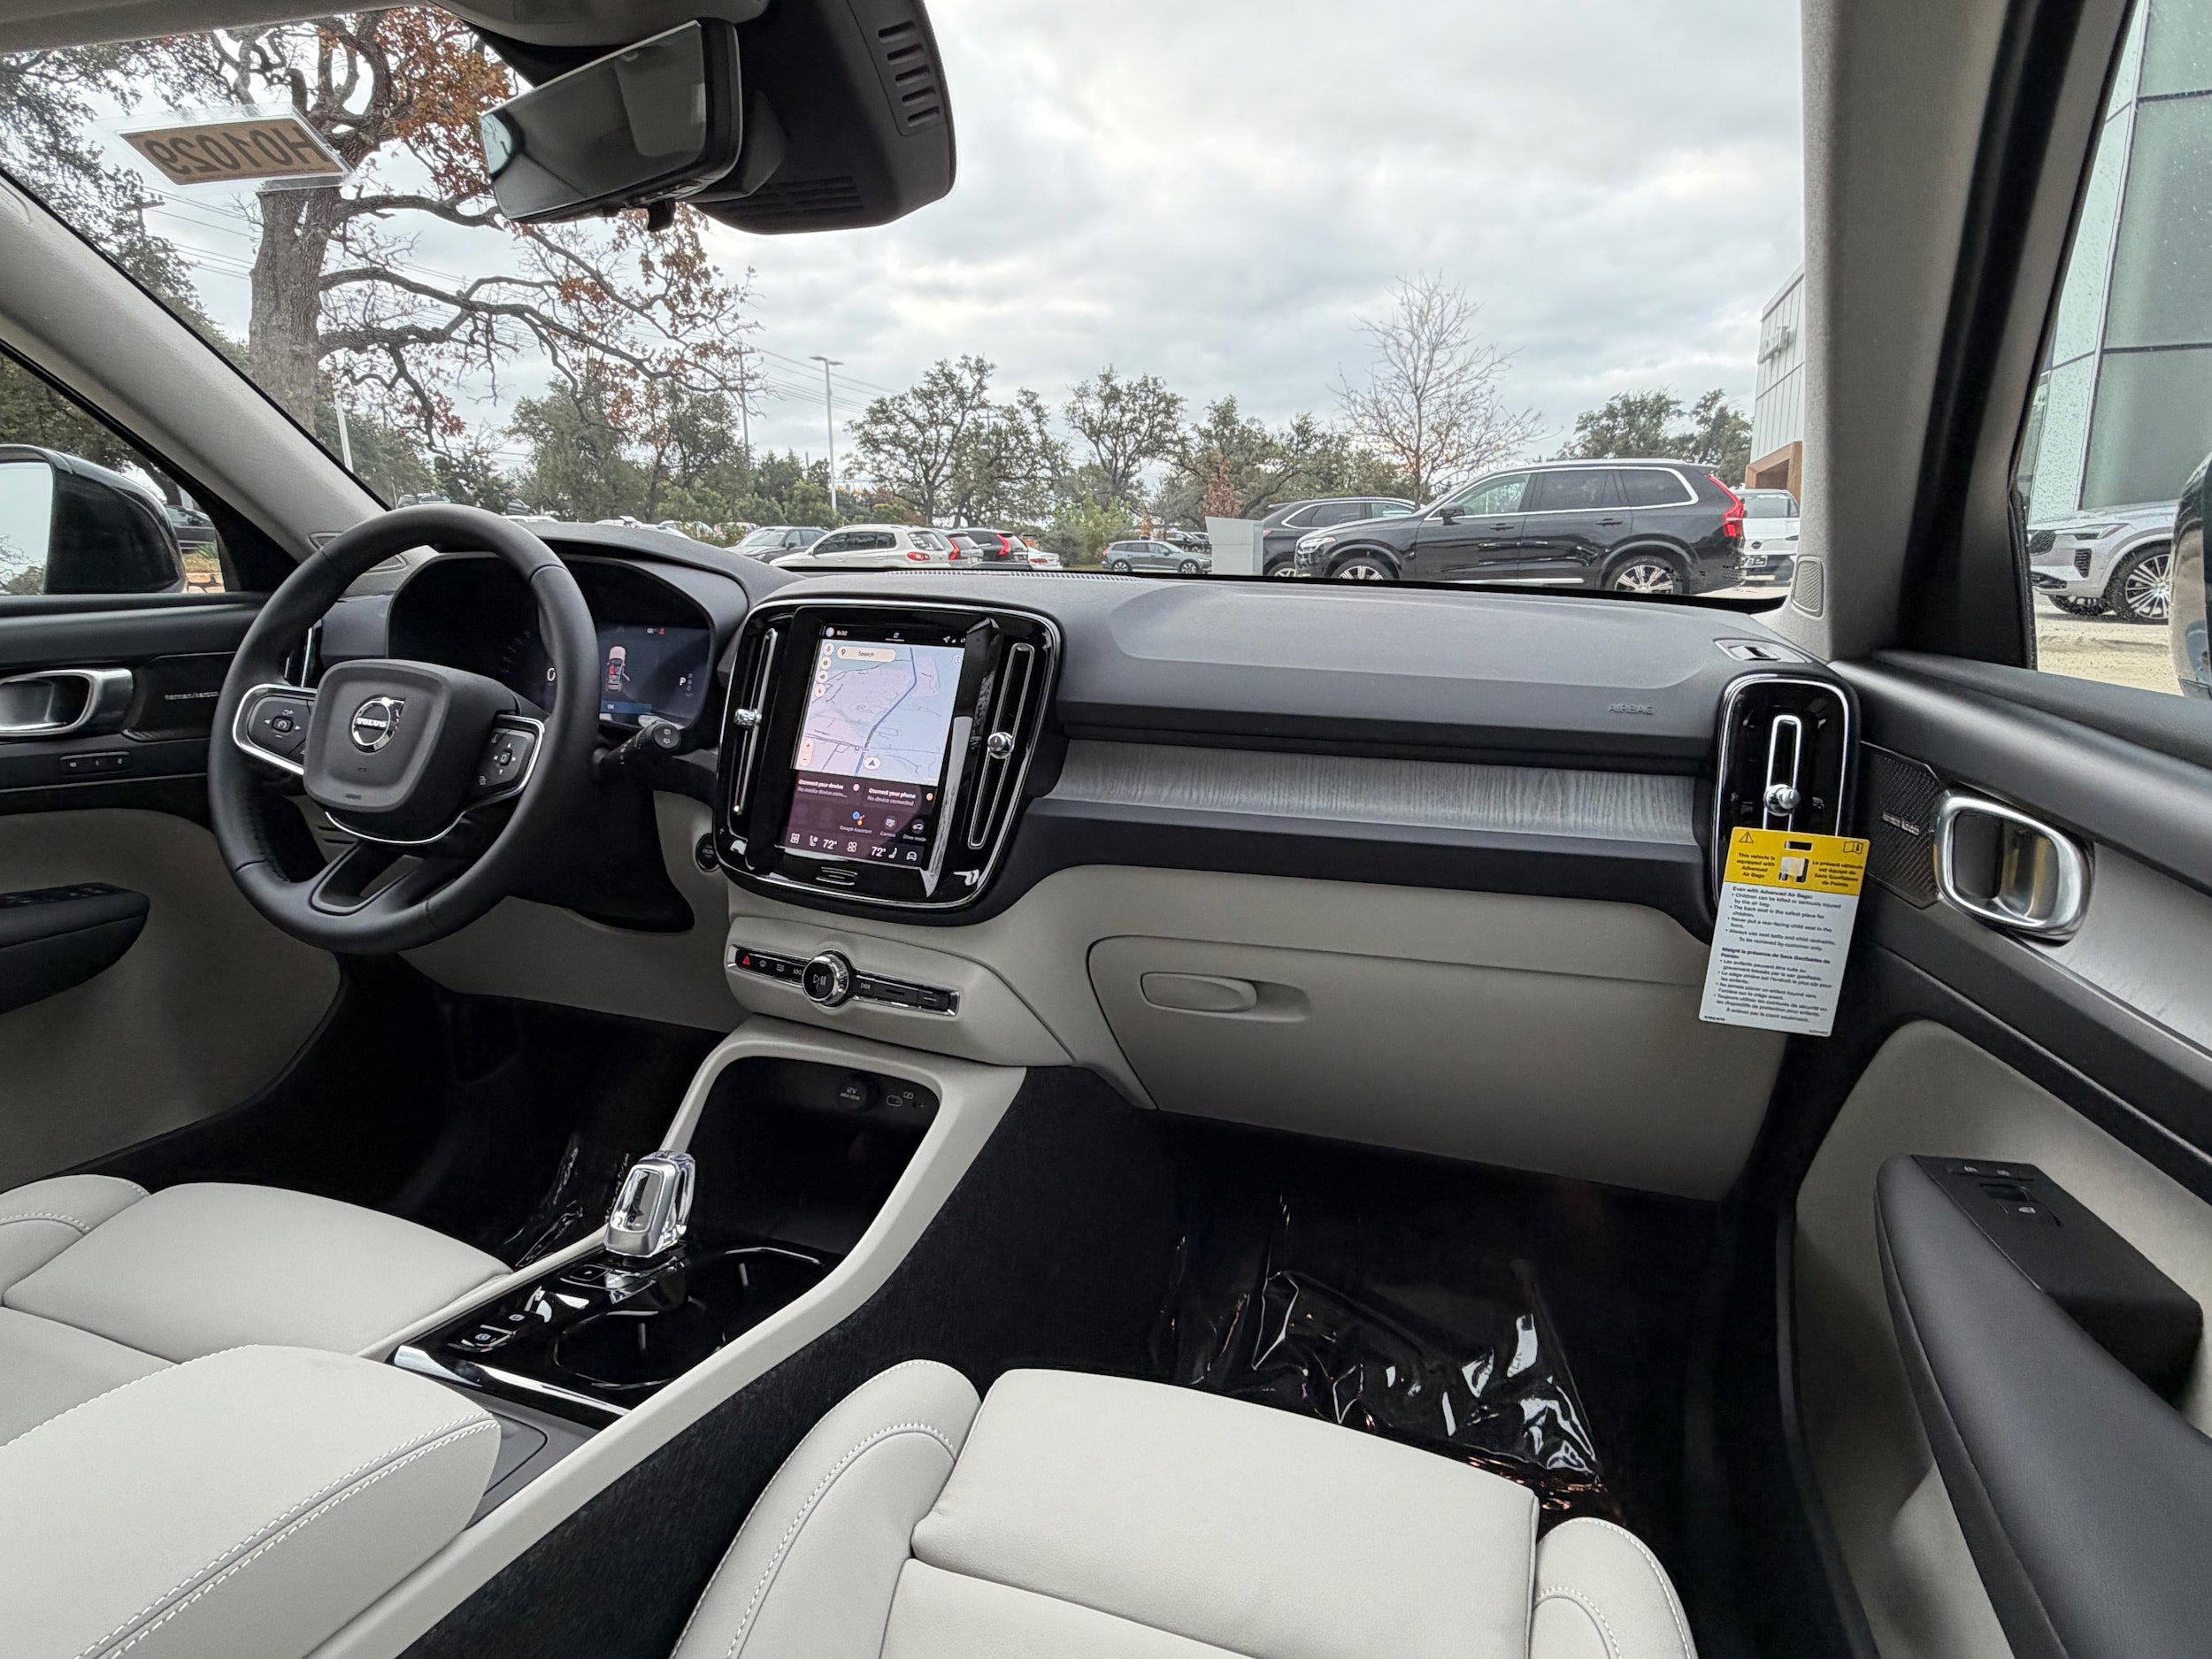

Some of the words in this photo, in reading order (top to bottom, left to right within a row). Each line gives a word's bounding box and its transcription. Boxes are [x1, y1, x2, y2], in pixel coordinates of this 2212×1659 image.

[546, 668, 556, 681] 0
[680, 677, 687, 686] P
[1608, 704, 1654, 715] AIRBAG
[357, 718, 387, 727] VOLVO
